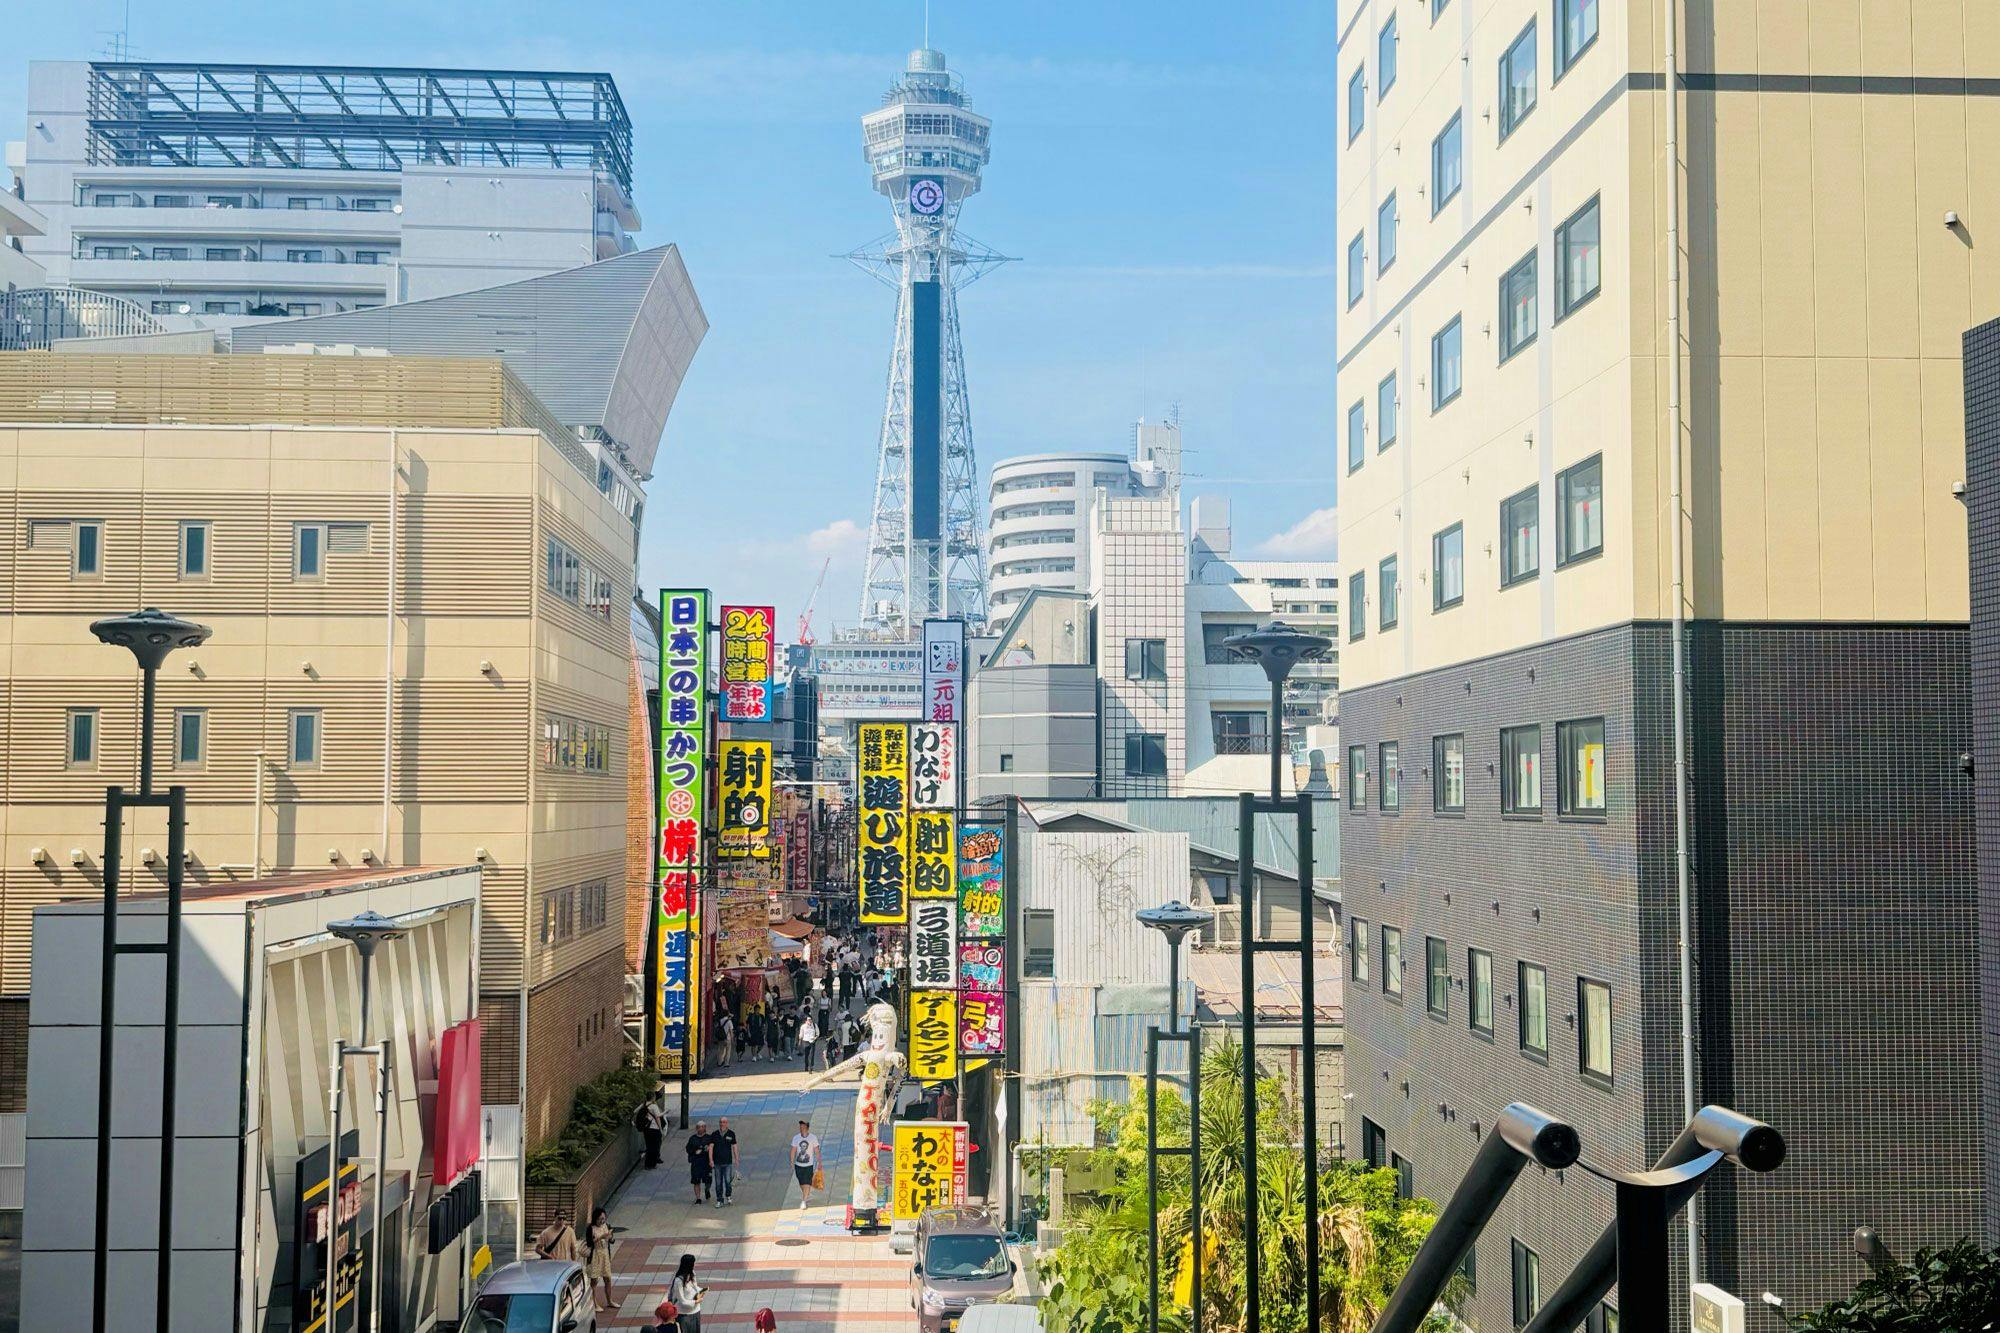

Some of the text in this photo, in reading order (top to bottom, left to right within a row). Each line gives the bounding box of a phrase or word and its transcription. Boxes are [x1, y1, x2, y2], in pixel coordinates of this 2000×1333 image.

[726, 611, 769, 638] 24
[726, 640, 767, 660] 時間
[665, 597, 698, 786] 日本一の串かつ
[725, 661, 767, 682] 営業
[728, 686, 764, 701] 年中
[728, 702, 765, 716] 無休
[933, 679, 955, 720] 元祖
[723, 746, 766, 832] 射的
[914, 728, 941, 804] わなげ
[663, 818, 697, 917] 横綱
[863, 775, 904, 917] 遊び放題
[915, 818, 951, 892] 射的
[962, 889, 1001, 916] 射的
[916, 906, 950, 983] 弓道場
[663, 930, 692, 1050] 通天閣店
[915, 996, 950, 1074] ゲームセンター
[912, 1132, 938, 1213] わなげ
[937, 1130, 950, 1166] 大人の
